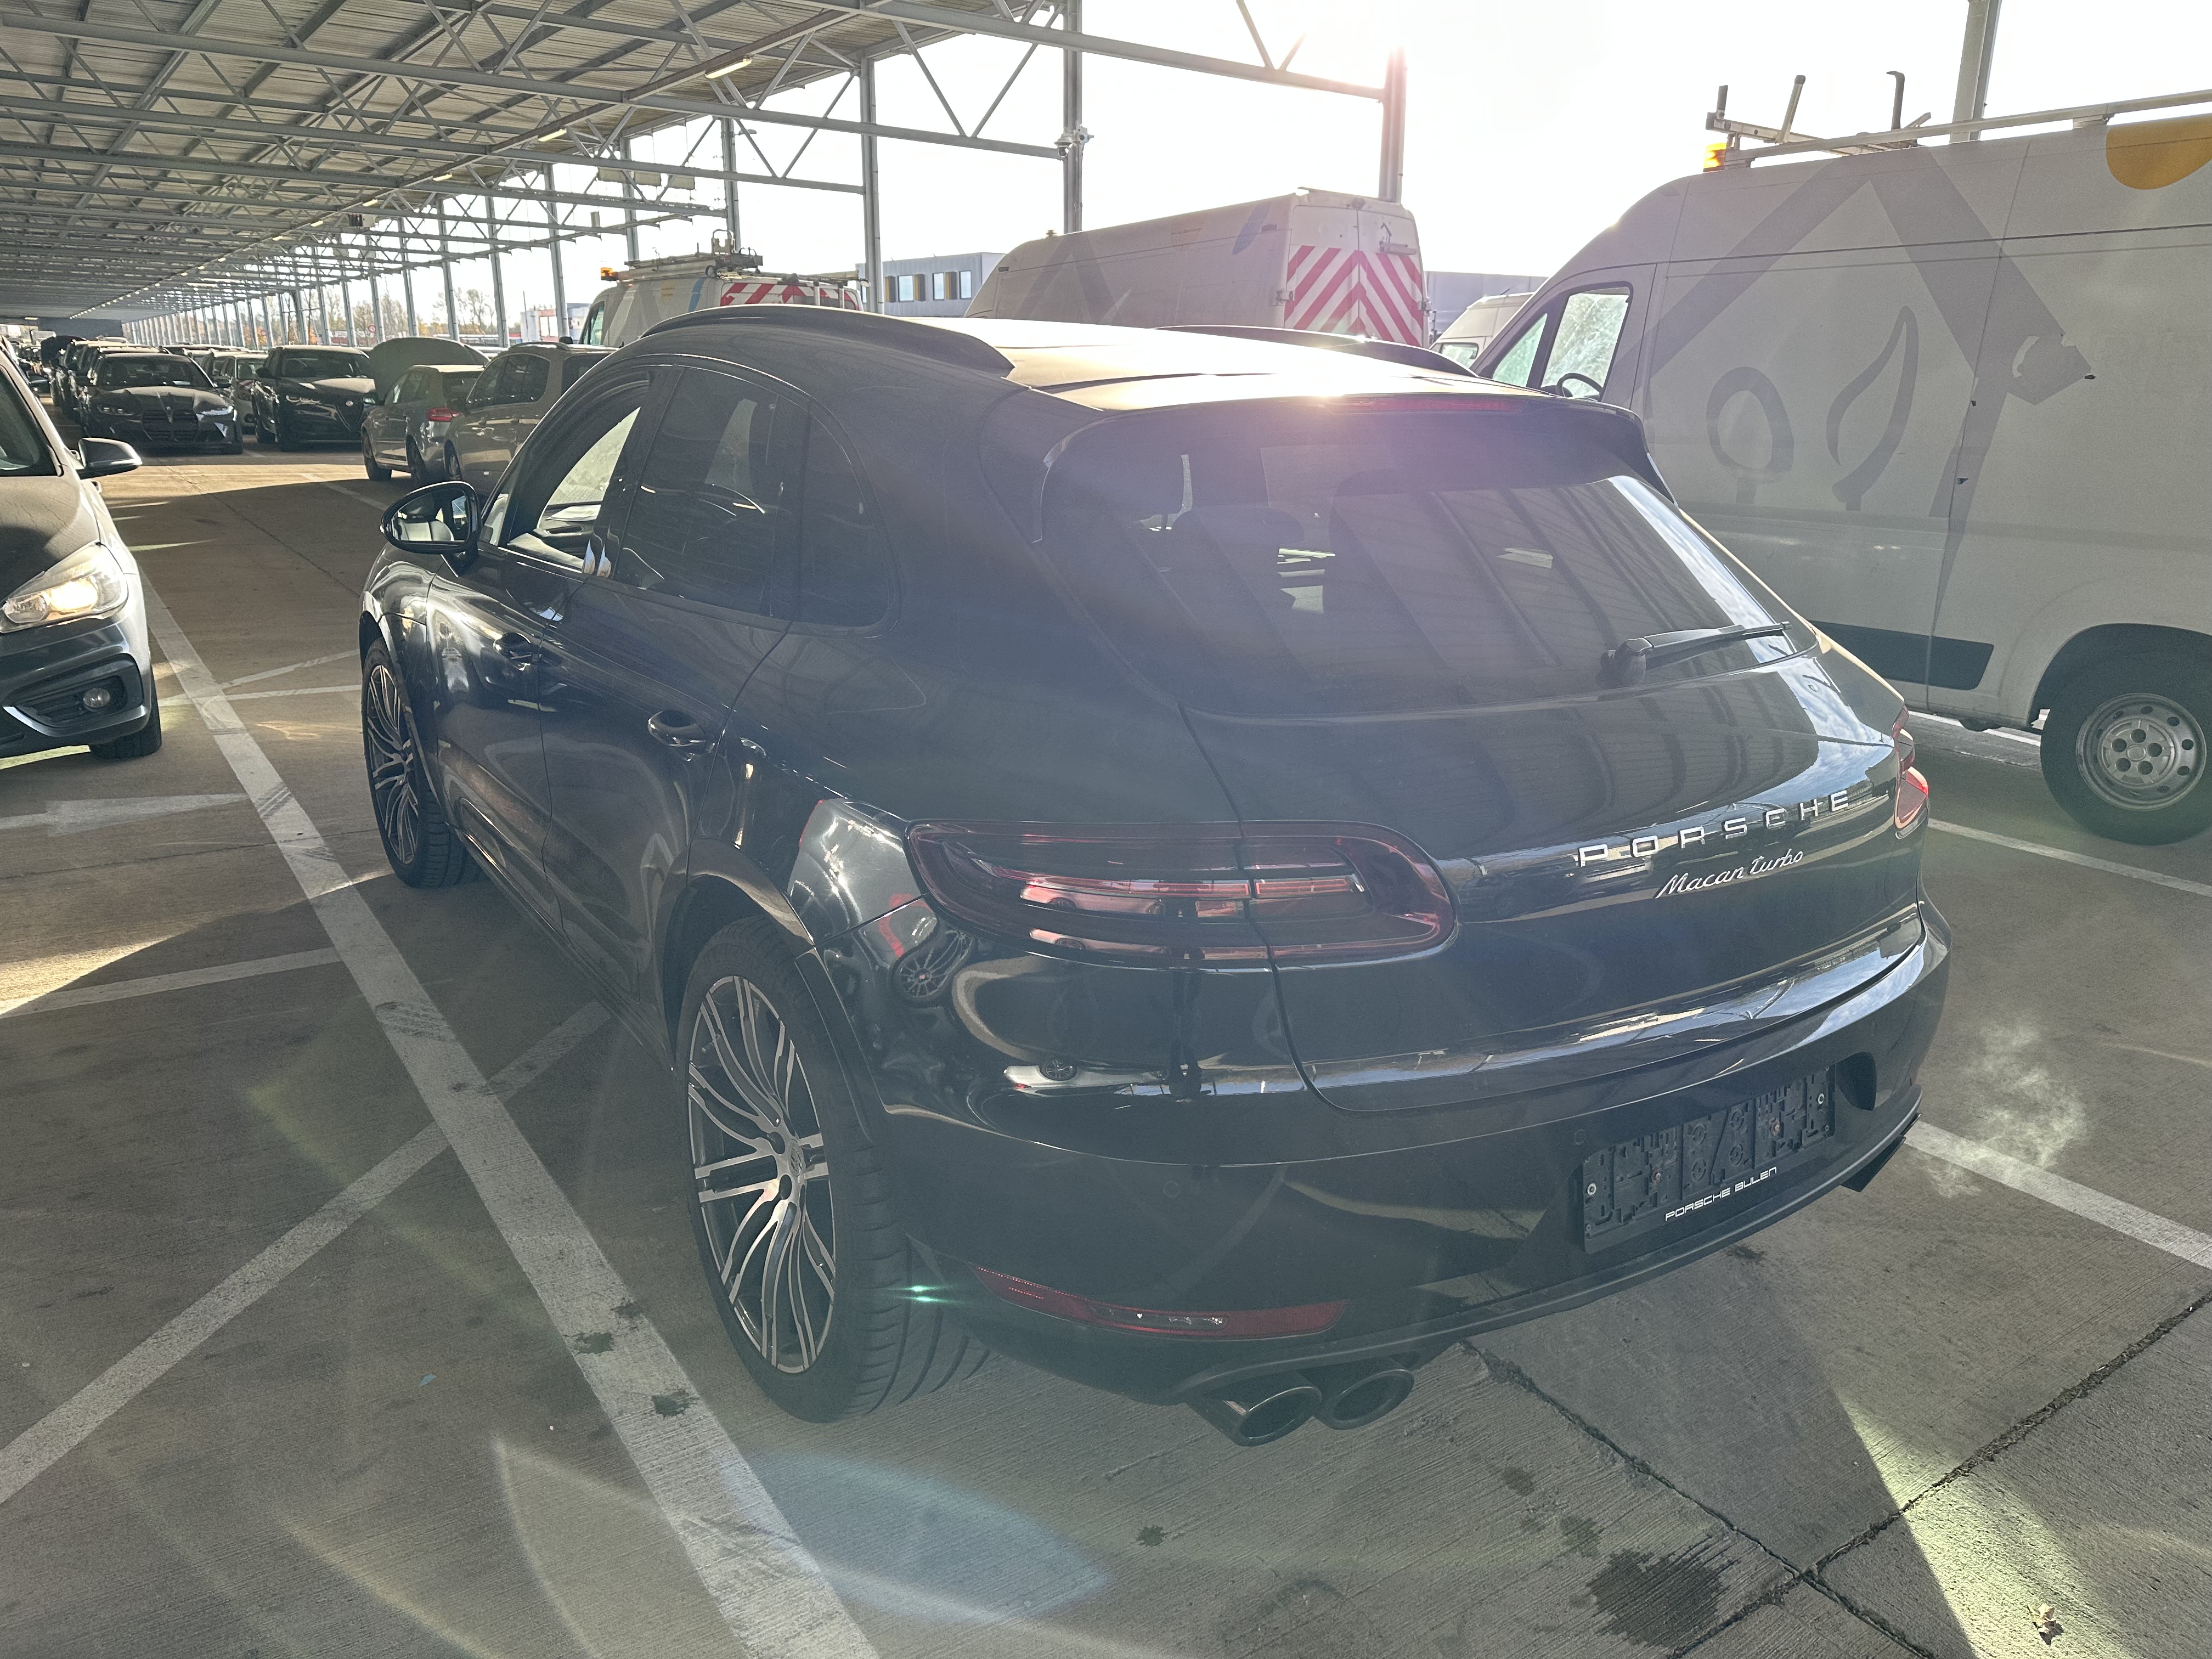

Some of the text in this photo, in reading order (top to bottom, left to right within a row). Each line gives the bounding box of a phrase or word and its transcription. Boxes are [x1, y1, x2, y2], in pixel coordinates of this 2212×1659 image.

[1578, 790, 1849, 867] PORSCHE
[1655, 866, 1744, 899] Macan
[1665, 1187, 1731, 1222] PORSCHE
